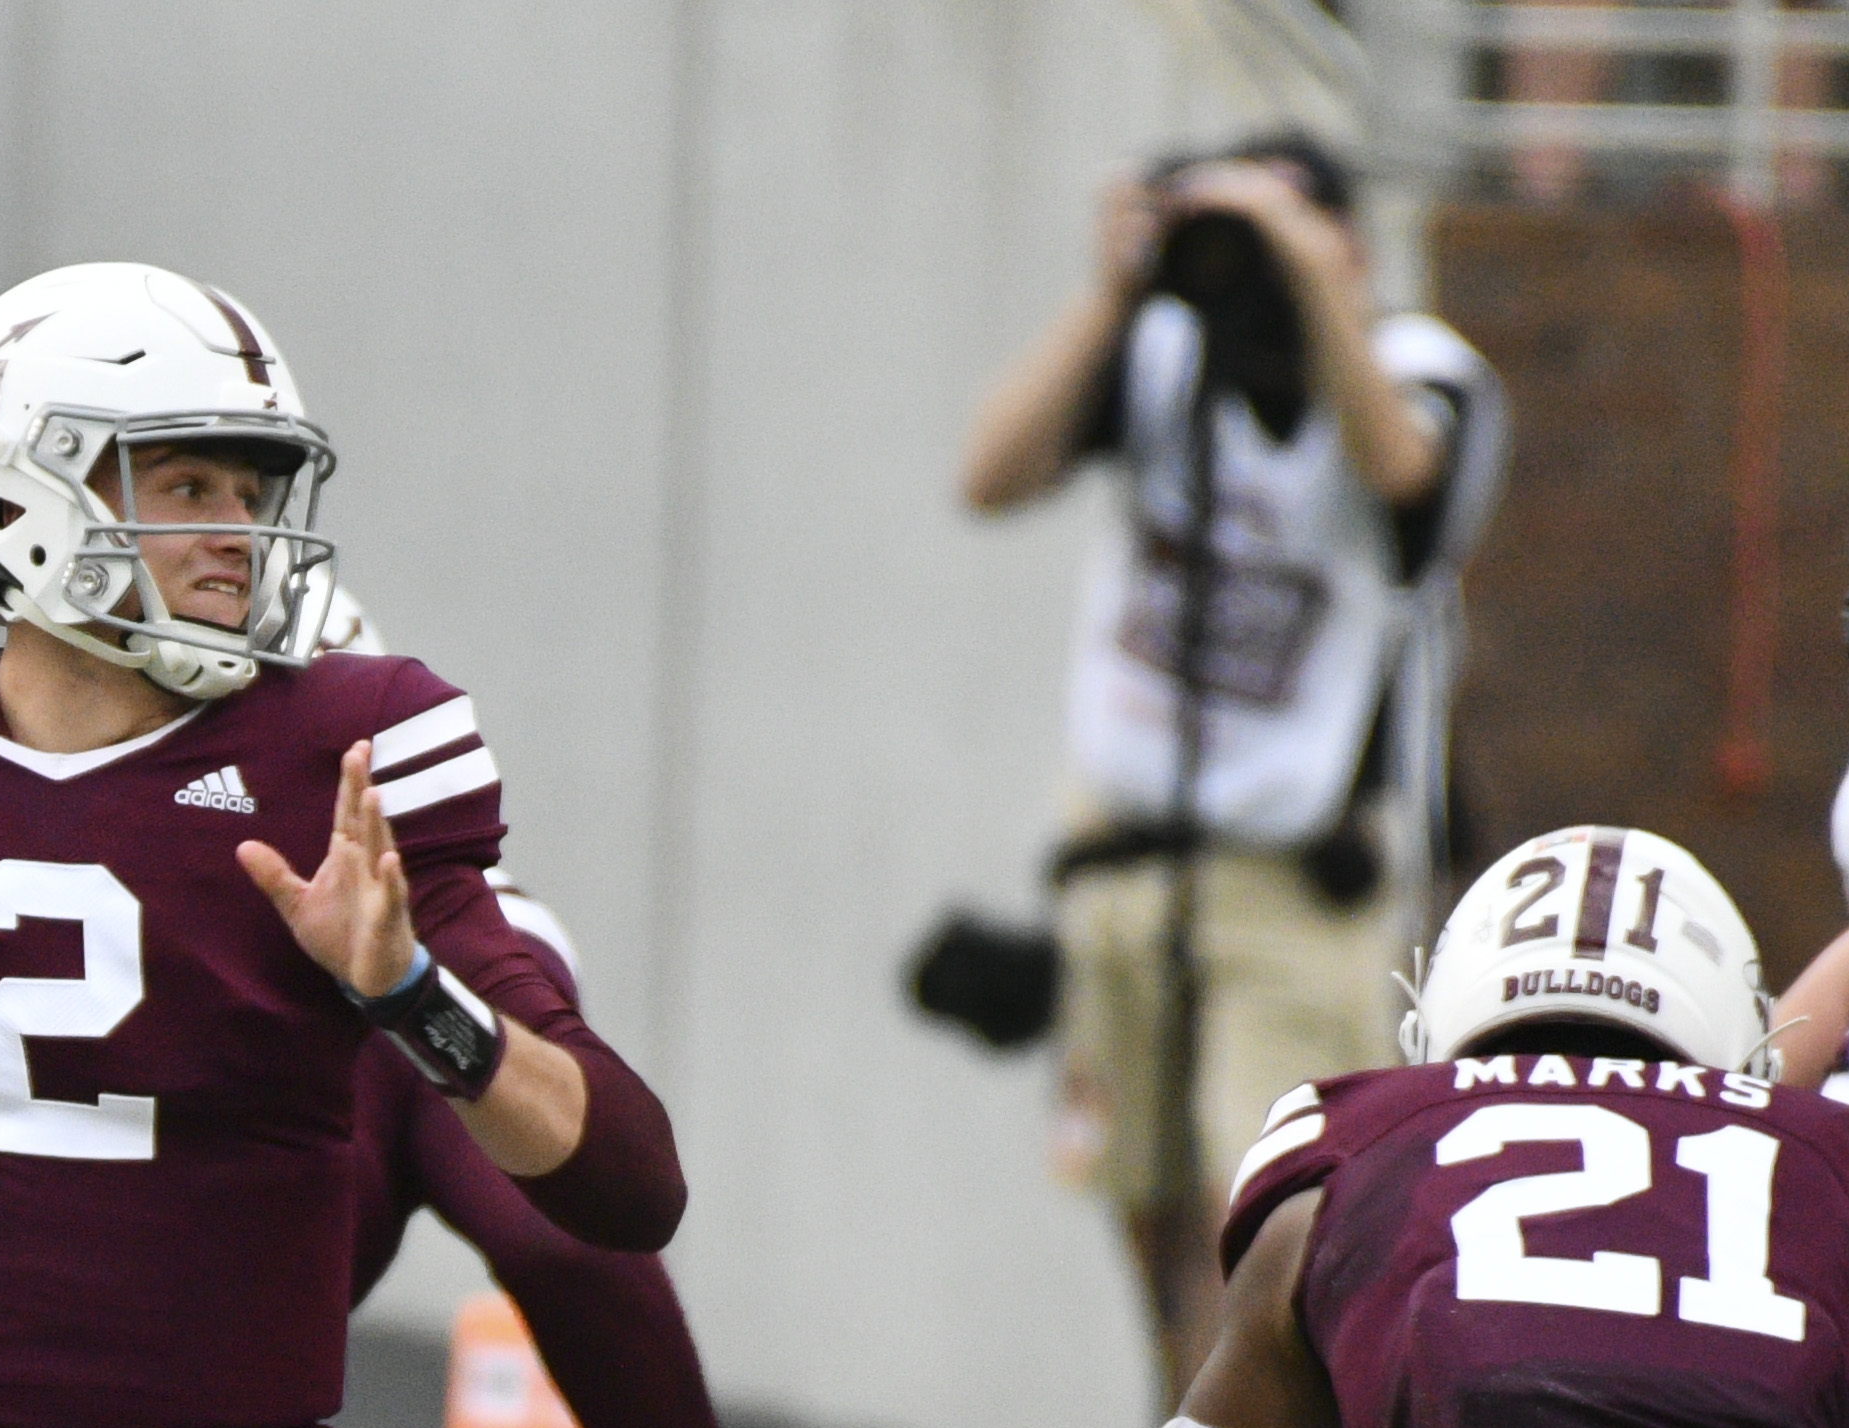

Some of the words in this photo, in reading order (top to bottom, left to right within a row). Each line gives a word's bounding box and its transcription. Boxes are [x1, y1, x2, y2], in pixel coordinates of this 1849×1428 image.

[174, 788, 256, 814] adidas
[1501, 969, 1660, 1014] BULLDOGS
[1453, 1054, 1773, 1109] MARKS
[1436, 1102, 1807, 1343] 21
